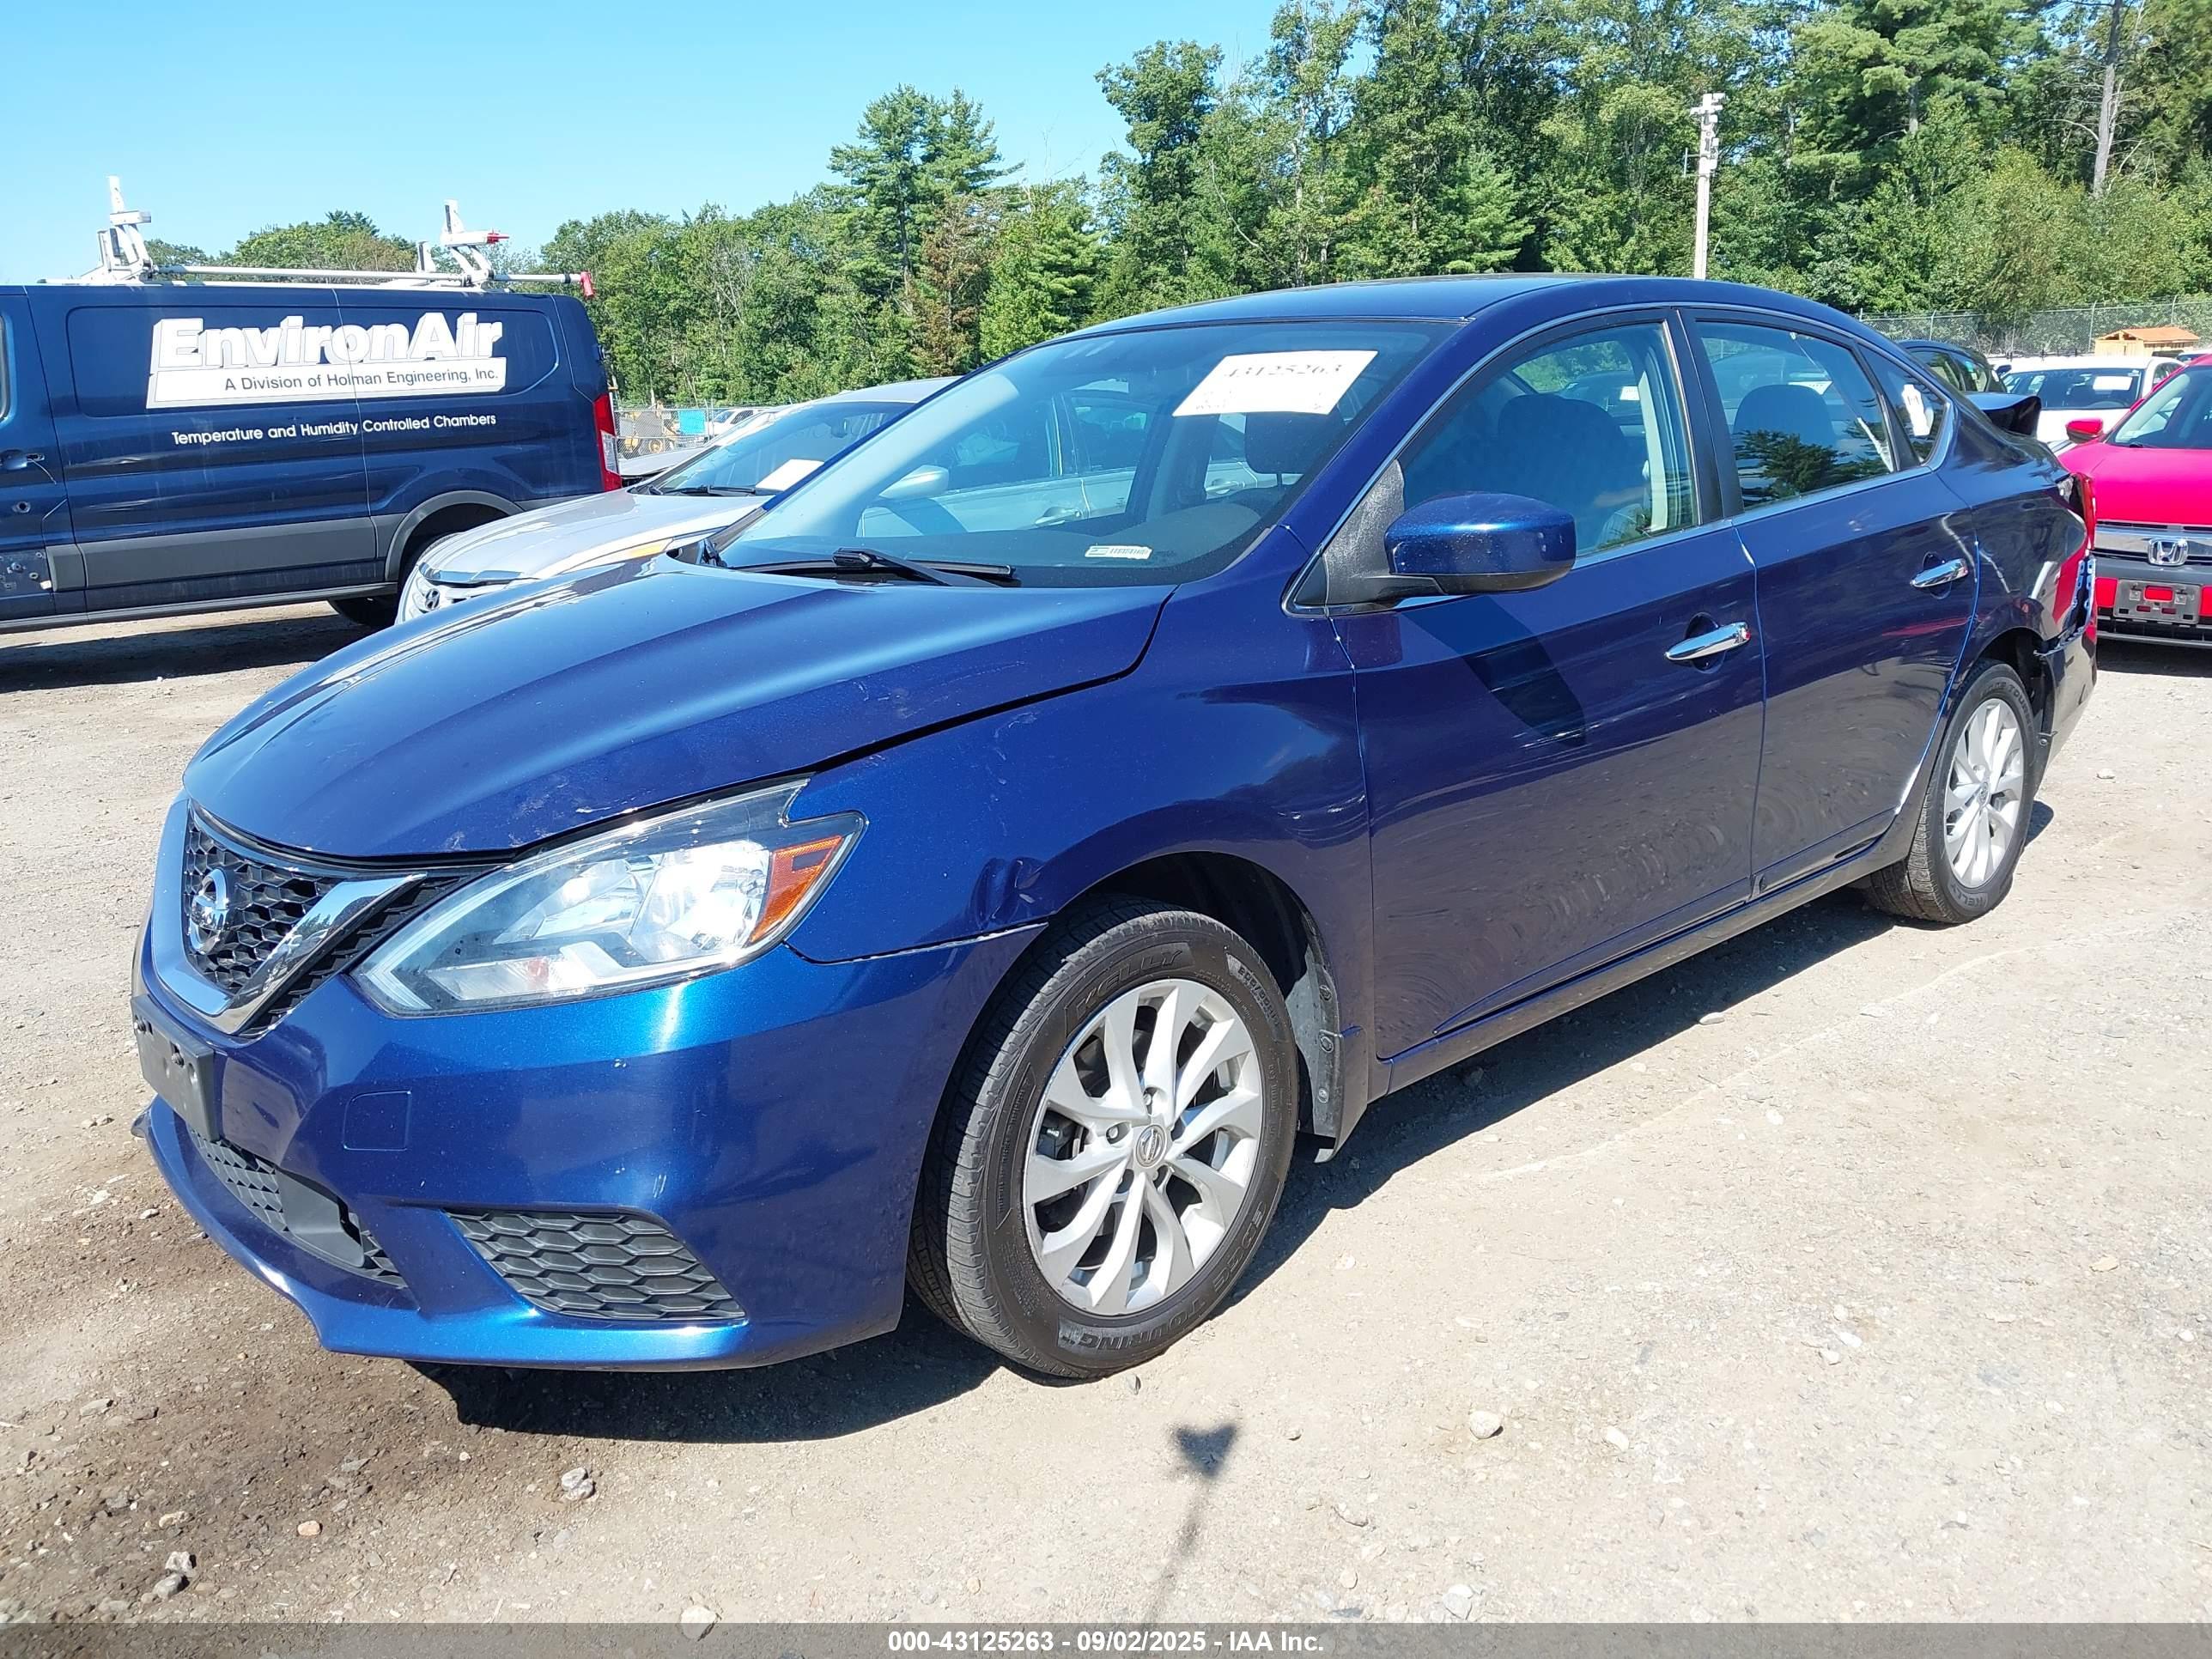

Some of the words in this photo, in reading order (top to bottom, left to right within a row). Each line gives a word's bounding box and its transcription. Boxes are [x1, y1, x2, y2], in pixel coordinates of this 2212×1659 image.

[151, 313, 502, 372] EnvironAir
[225, 378, 236, 391] A
[241, 374, 302, 391] Division
[307, 374, 322, 387] of
[327, 373, 381, 386] Holman
[386, 368, 471, 386] Engineering,
[475, 368, 498, 380] Inc.
[172, 428, 263, 446] Temperature
[268, 424, 296, 439] and
[301, 421, 358, 436] Humidity
[362, 416, 429, 432] Controlled
[434, 414, 496, 428] Chambers
[1076, 949, 1183, 1019] KELLY
